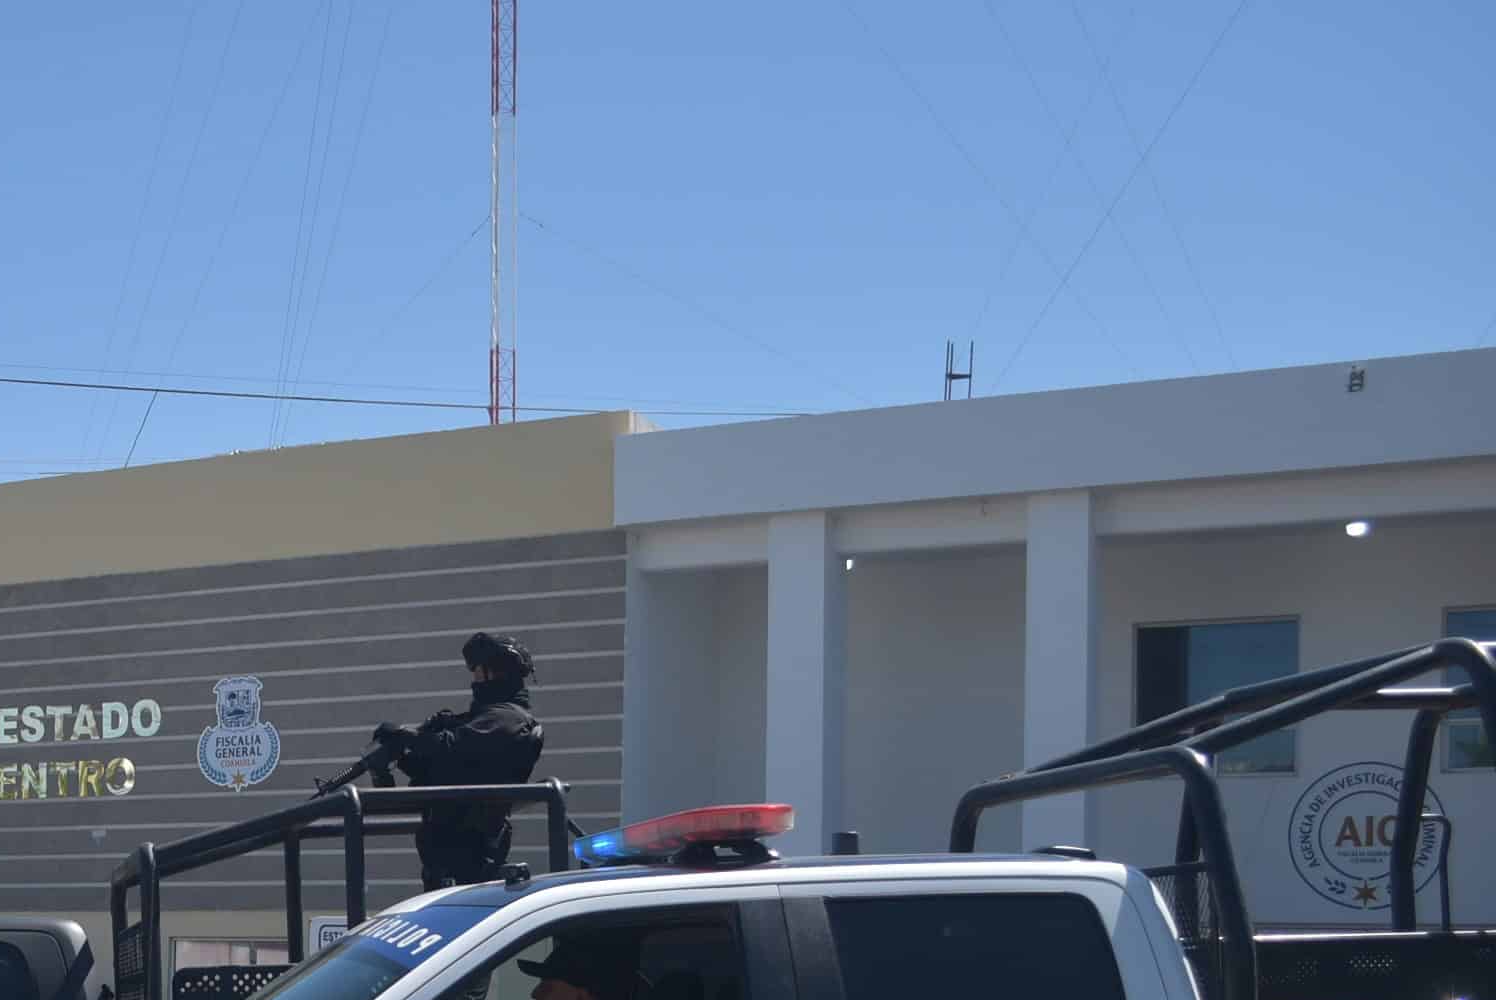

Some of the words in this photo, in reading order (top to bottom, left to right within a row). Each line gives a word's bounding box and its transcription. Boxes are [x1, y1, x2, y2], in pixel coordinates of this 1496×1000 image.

[215, 734, 262, 748] FISCALIA
[215, 746, 263, 759] GENERAL
[1309, 794, 1326, 813] DE
[1299, 813, 1320, 868] AGENCIA
